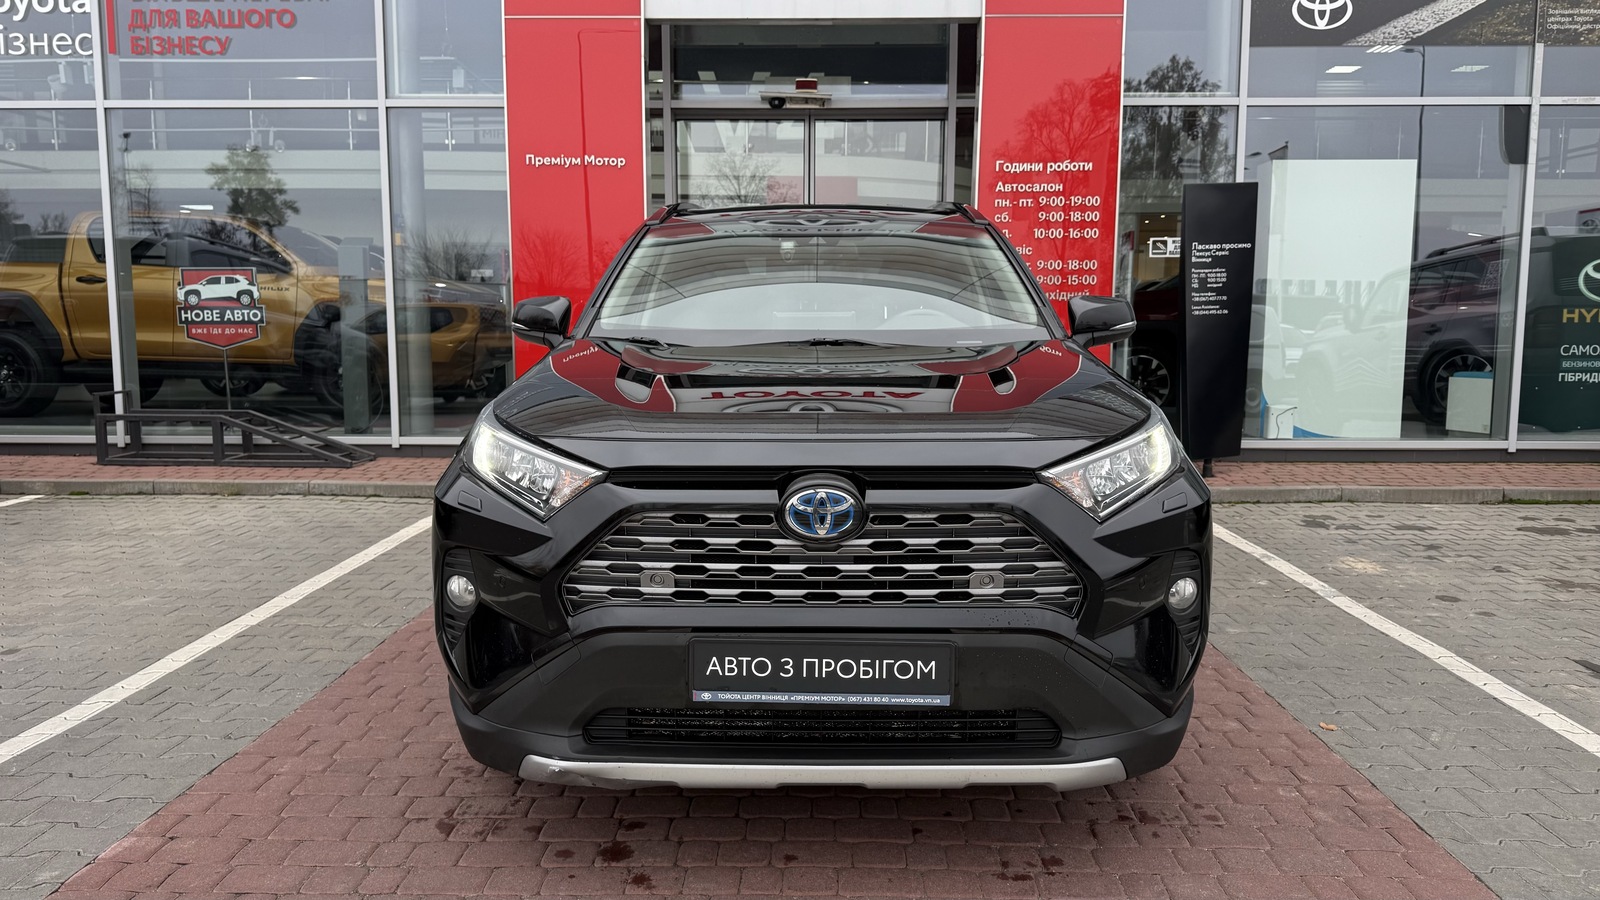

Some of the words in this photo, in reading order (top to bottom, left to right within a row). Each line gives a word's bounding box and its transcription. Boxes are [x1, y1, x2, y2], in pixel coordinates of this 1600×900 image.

[128, 9, 178, 31] ДЛЯ
[186, 9, 295, 28] ВАШОГО
[130, 36, 230, 54] БІЗНЕСУ
[525, 154, 581, 168] Преміум
[584, 155, 626, 168] Мотор
[995, 160, 1043, 174] Години
[1047, 160, 1093, 174] роботи
[995, 182, 1063, 192] Автосалон
[1039, 195, 1100, 207] 9:00-19:00
[994, 212, 1012, 222] сб.
[1038, 211, 1100, 222] 9:00-18:00
[1033, 228, 1099, 239] 10:00-16:00
[1192, 242, 1221, 250] Ласкаво
[1036, 259, 1098, 270] 9:00-18:00
[1036, 275, 1097, 285] 9:00-15:00
[181, 309, 221, 322] НОВЕ
[224, 309, 261, 322] АВТО
[1563, 308, 1600, 323] HY
[210, 327, 222, 335] ЇДЕ
[1560, 344, 1600, 356] САМО
[1558, 372, 1600, 383] ГІБРИД
[706, 656, 772, 677] АВТО
[779, 658, 794, 677] З
[803, 658, 936, 680] ПРОБІГОМ
